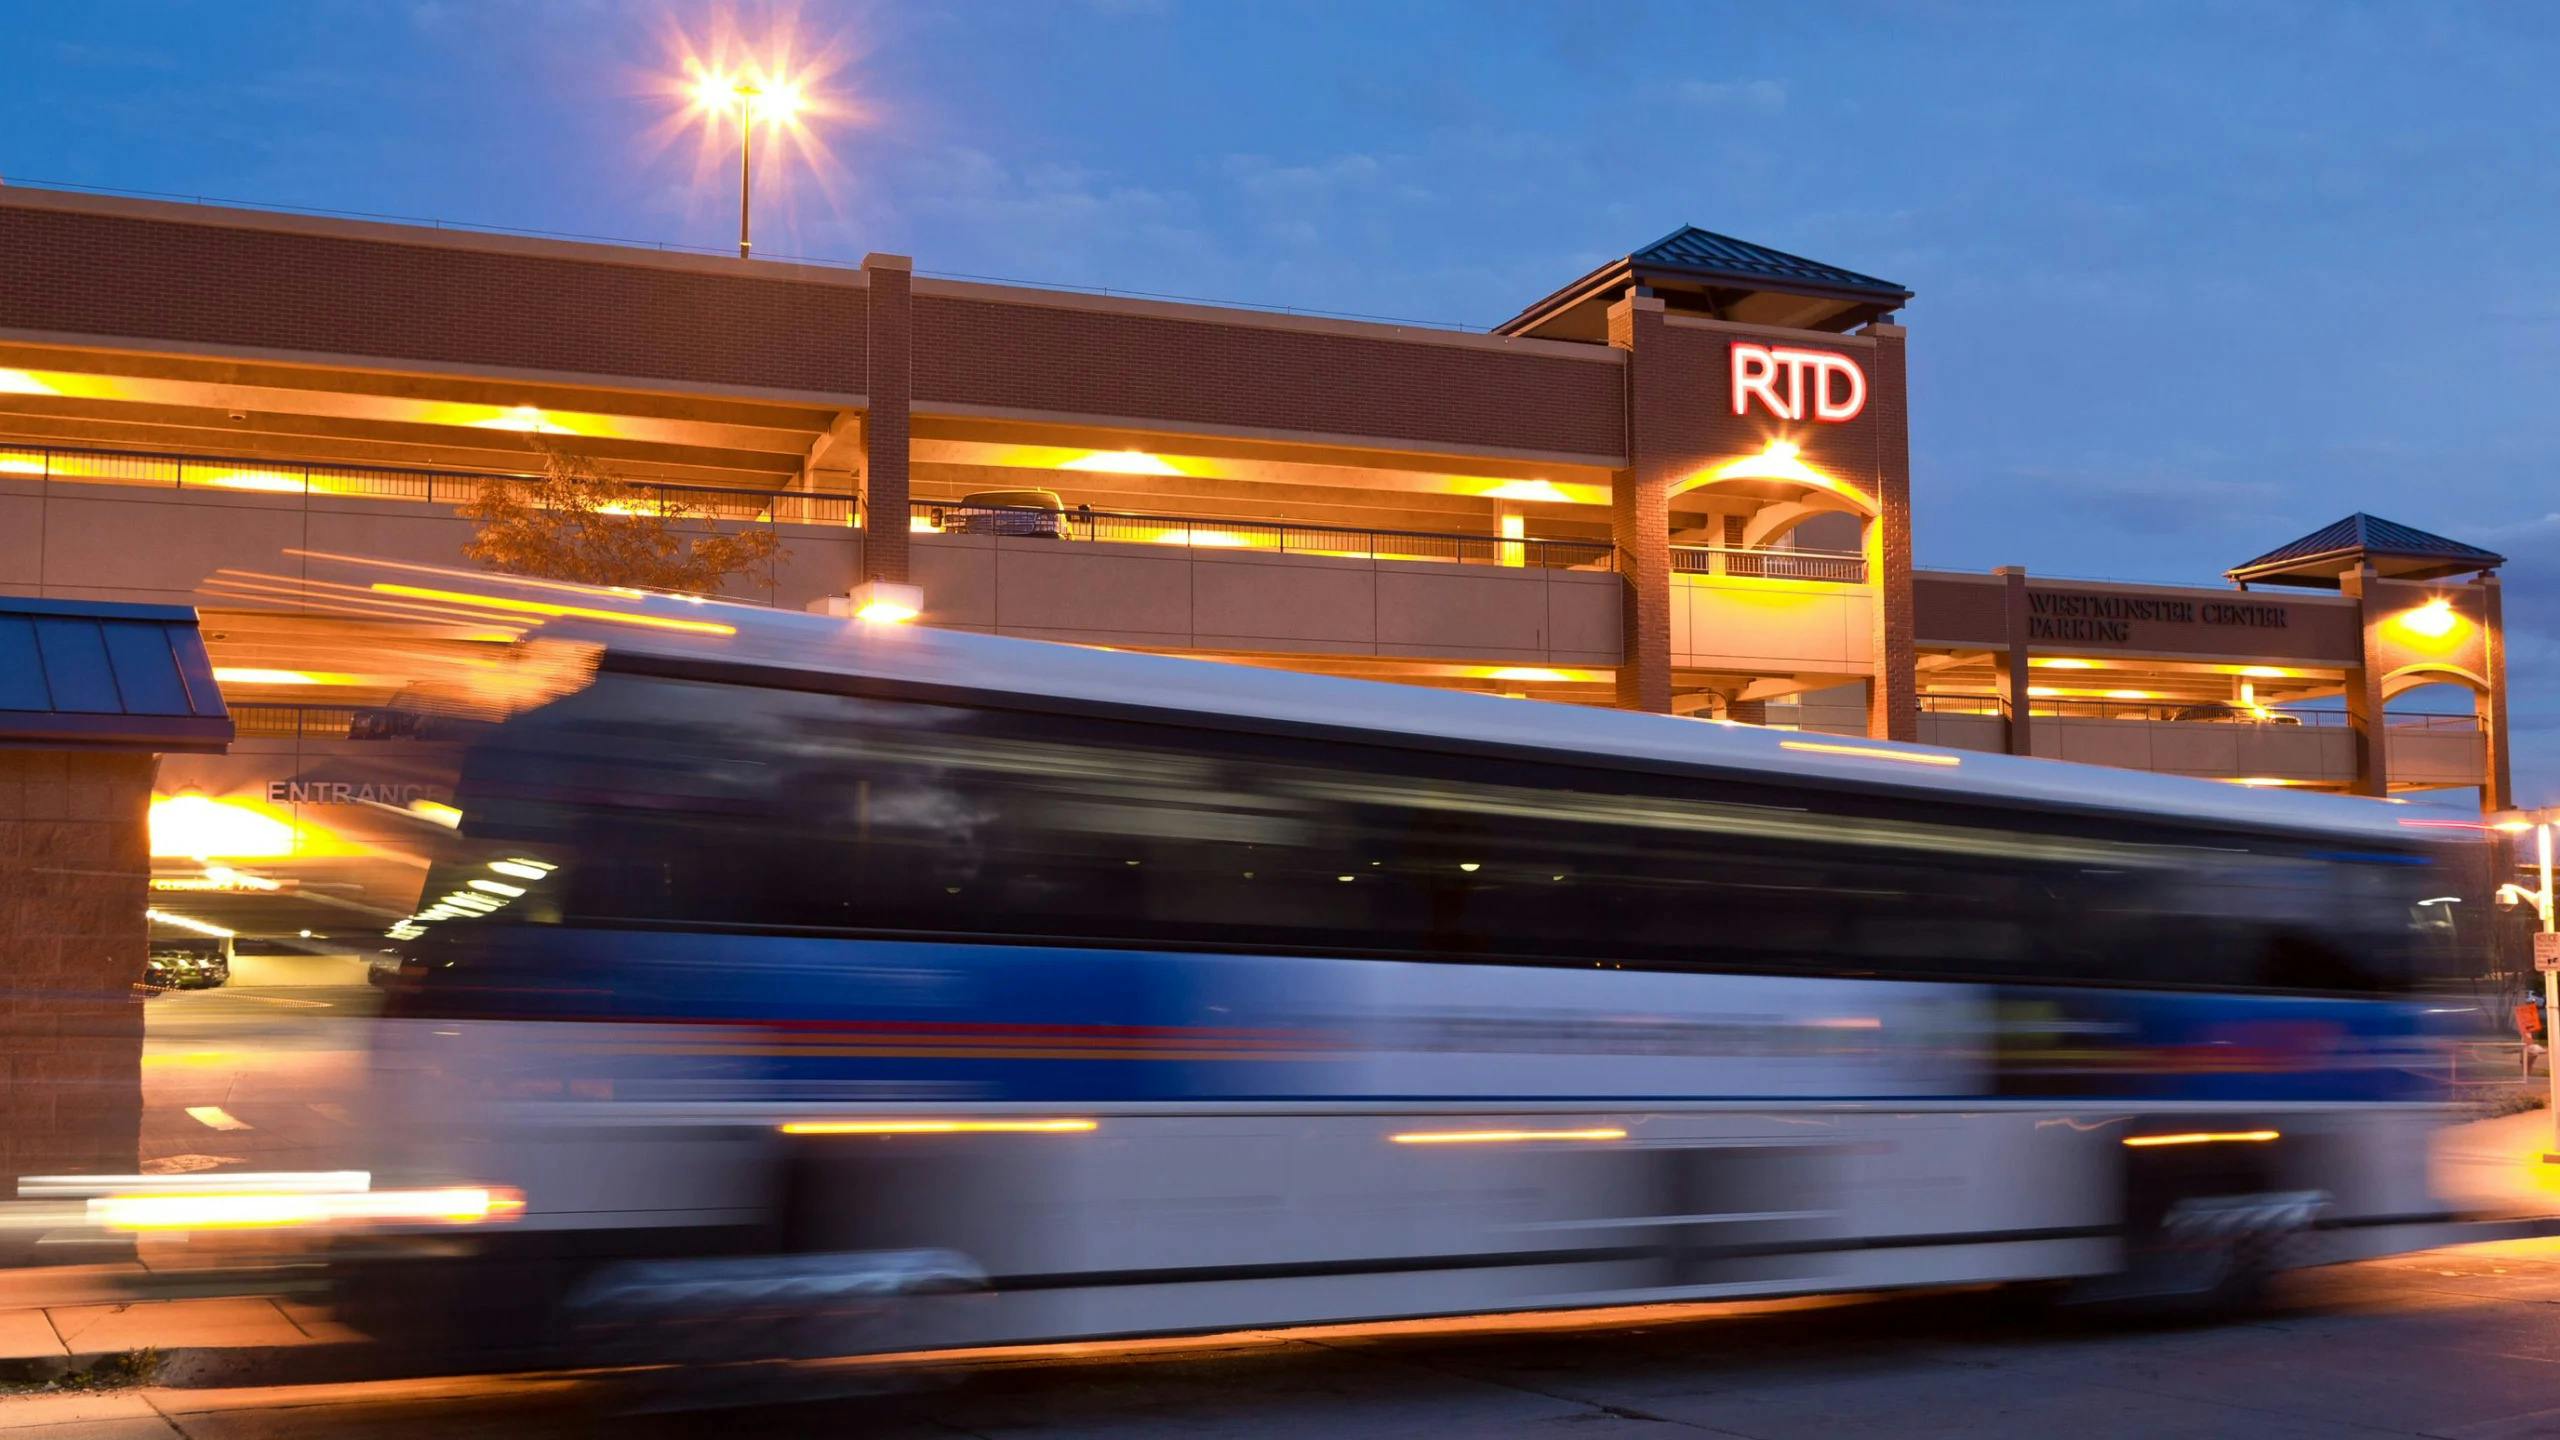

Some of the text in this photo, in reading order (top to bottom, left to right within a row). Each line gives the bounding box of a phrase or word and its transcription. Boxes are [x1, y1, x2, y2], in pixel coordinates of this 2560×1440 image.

[1731, 342, 1867, 422] RTD
[2028, 593, 2287, 628] WESTMINSTER CENTER
[2029, 616, 2128, 642] PARKING
